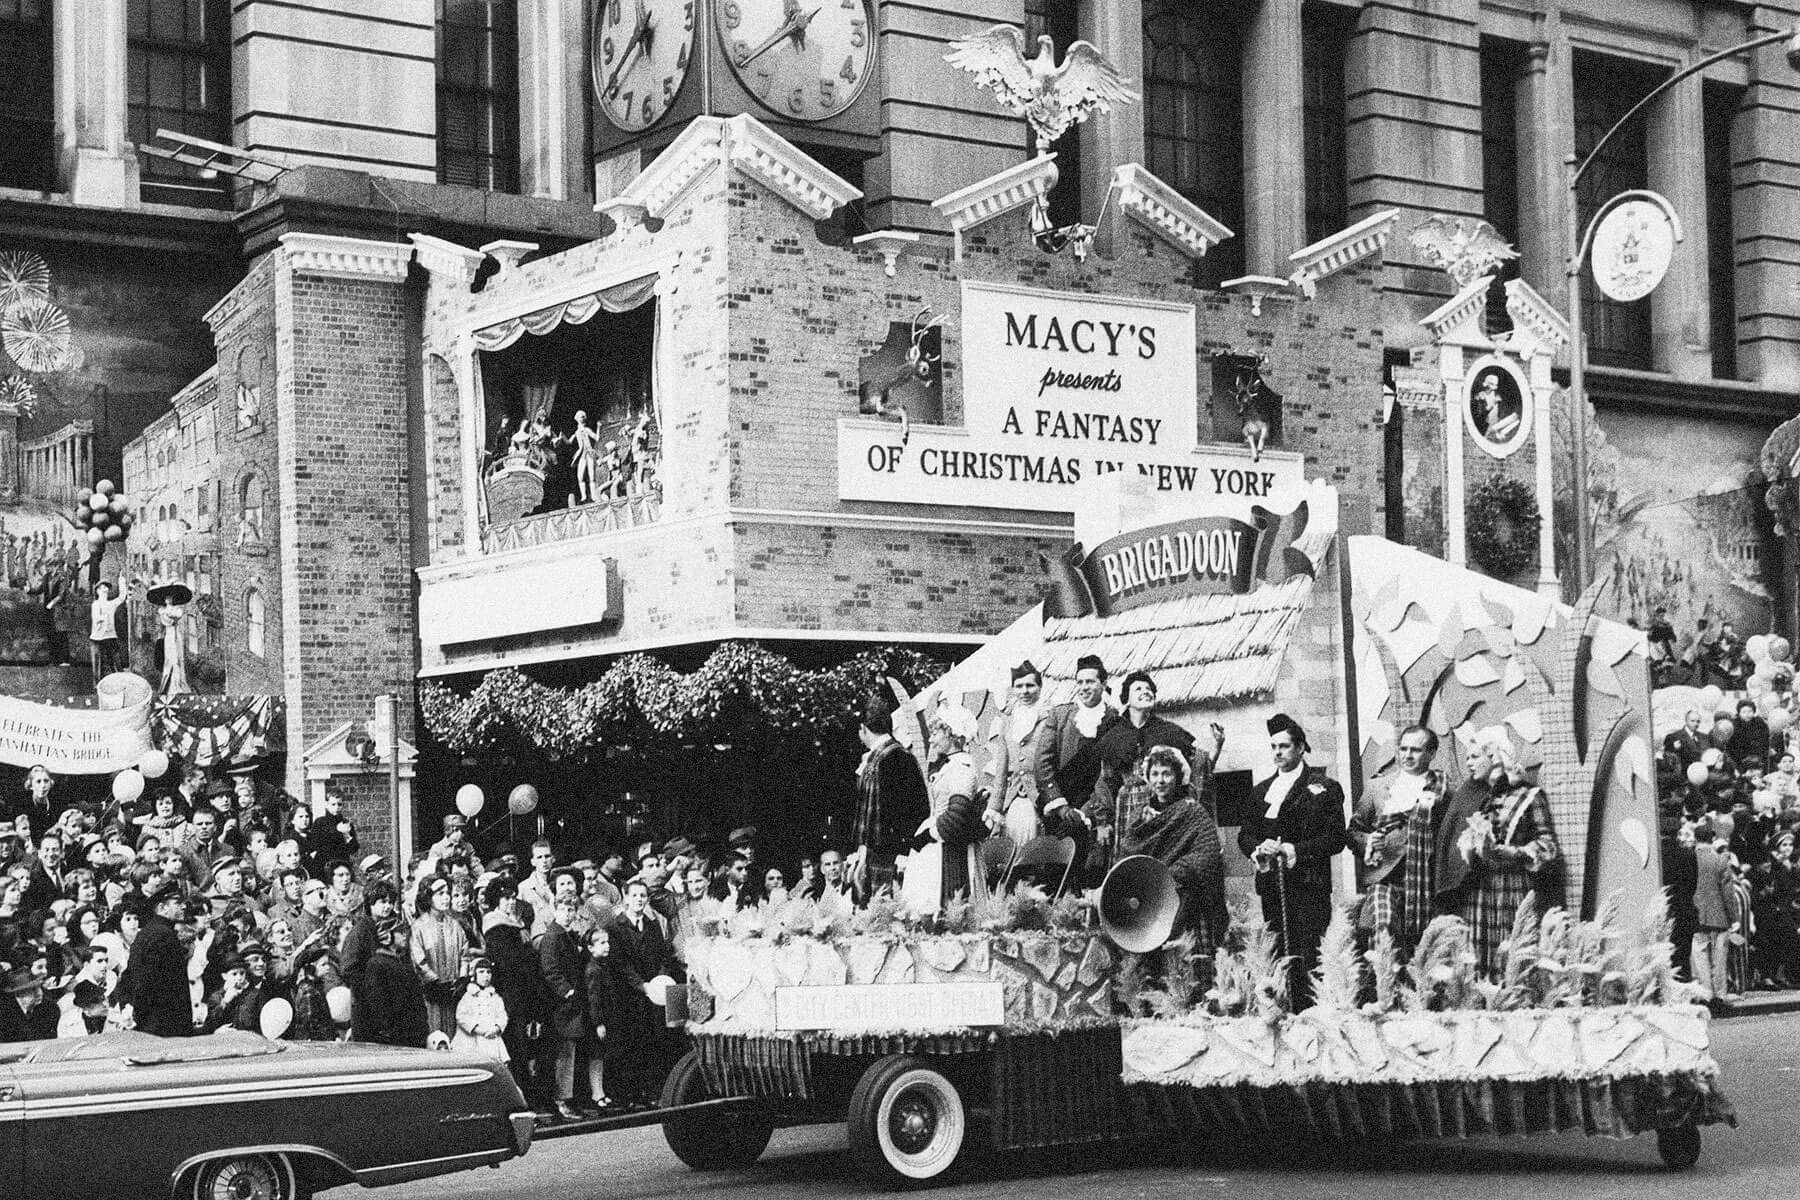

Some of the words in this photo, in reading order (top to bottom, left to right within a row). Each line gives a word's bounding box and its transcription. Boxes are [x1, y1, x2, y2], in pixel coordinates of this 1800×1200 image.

[683, 2, 693, 32] 3
[725, 1, 741, 28] 9
[850, 19, 866, 47] 3
[603, 37, 614, 65] 9
[677, 42, 688, 70] 4
[839, 55, 857, 84] 4
[622, 91, 634, 121] 7
[788, 88, 803, 113] 6
[820, 79, 834, 107] 5
[642, 95, 654, 123] 6
[1004, 312, 1156, 360] MACY'S
[1037, 366, 1122, 398] presents
[1001, 406, 1023, 435] A
[1034, 410, 1162, 446] FANTASY
[867, 444, 904, 473] OF
[920, 448, 1082, 484] CHRISTMAS
[1210, 468, 1276, 497] YORK
[1102, 529, 1242, 596] BRIGADOON
[1, 719, 73, 740] ELEBRATES
[0, 737, 68, 759] ANHATTAN
